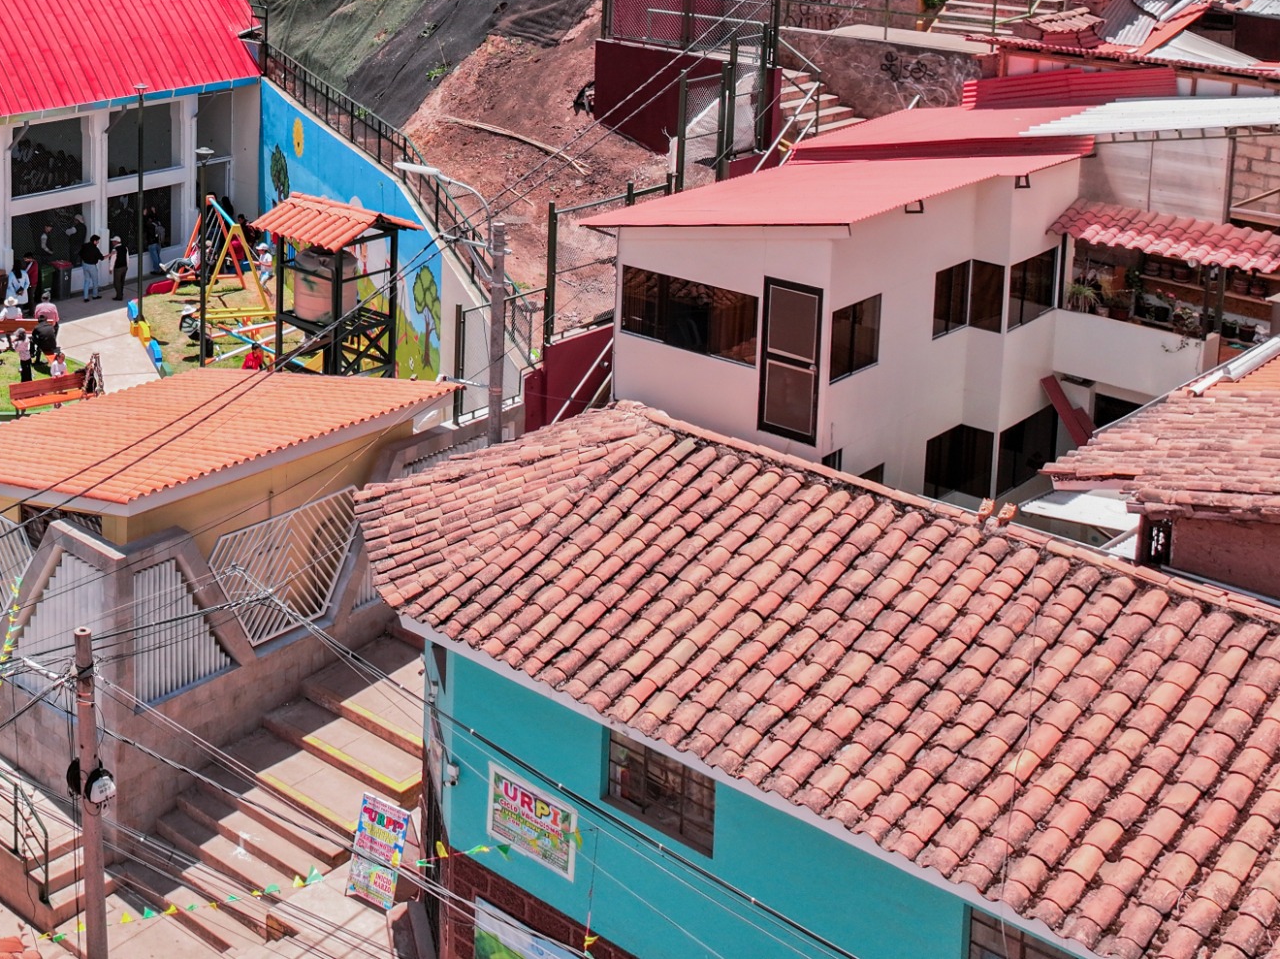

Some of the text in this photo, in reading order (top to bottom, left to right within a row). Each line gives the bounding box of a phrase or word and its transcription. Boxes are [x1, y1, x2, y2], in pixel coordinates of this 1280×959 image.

[499, 799, 519, 814] CICLO
[503, 781, 562, 828] URPI
[373, 879, 393, 894] MARZO
[375, 872, 393, 886] INICIO
